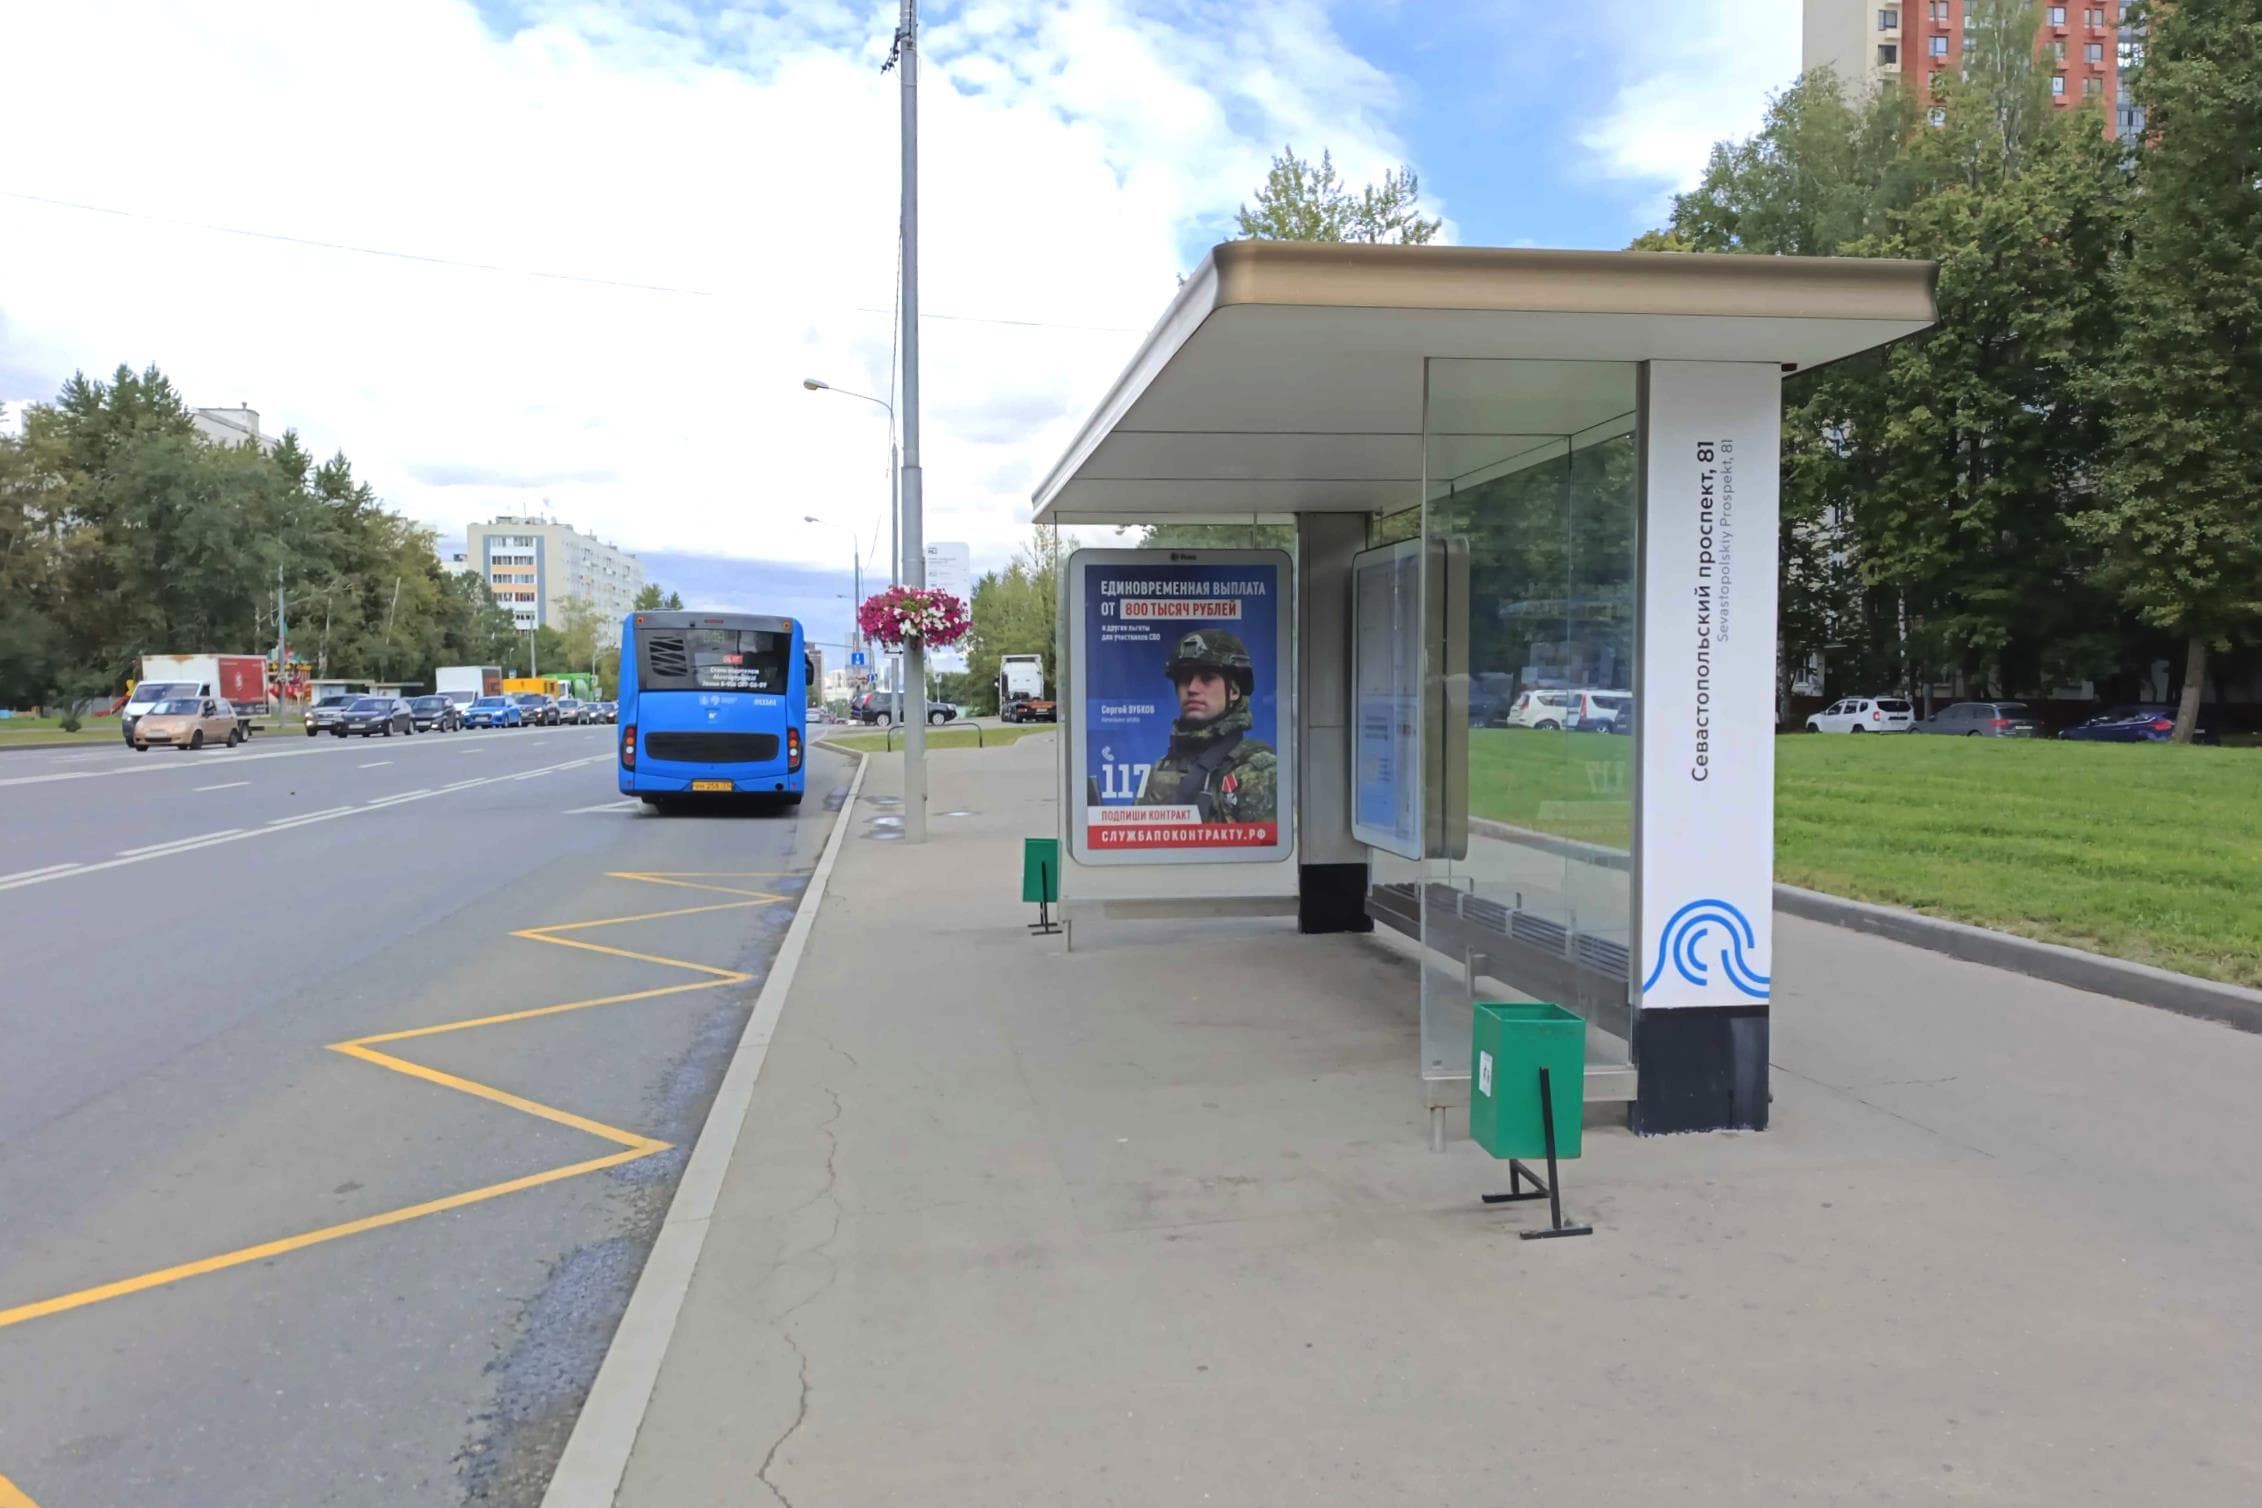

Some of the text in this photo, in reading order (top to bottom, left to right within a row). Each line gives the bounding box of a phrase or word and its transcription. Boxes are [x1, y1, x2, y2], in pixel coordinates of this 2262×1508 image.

[1717, 439, 1735, 642] Sevastopolskiy Prospekt, 81
[1100, 580, 1266, 596] ЕДИНОВРЕМЕННАЯ ВЫПЛАТА
[1101, 600, 1237, 616] ОТ 800 ТЫСЯЧ РУБЛЕЙ
[1691, 441, 1718, 782] Севастопольский проспект, 81
[1101, 763, 1151, 799] 117
[1101, 809, 1191, 822] ПОДПИШИ КОНТРАКТ
[1101, 828, 1267, 843] СЛУЖБАПОКОНТРАКТУ.РФ
